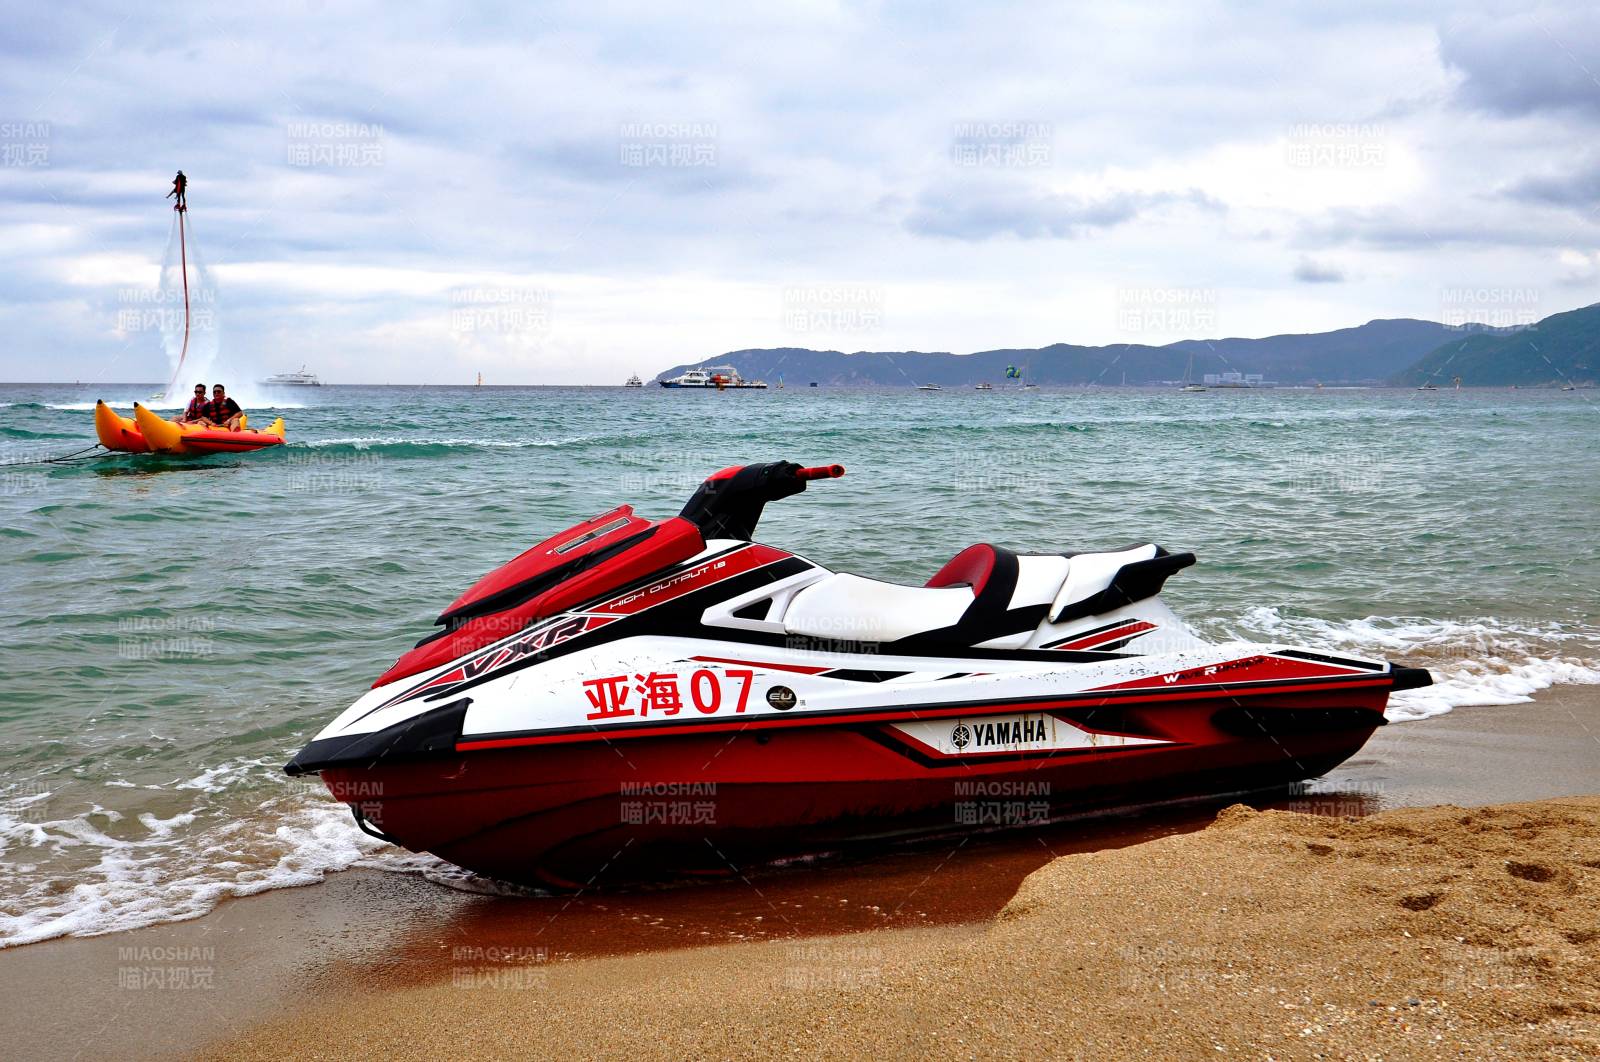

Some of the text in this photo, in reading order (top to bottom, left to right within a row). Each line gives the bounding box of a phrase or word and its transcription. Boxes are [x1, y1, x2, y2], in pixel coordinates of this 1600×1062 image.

[609, 591, 645, 609] HIGH
[649, 566, 709, 594] OUTPUT
[462, 615, 590, 680] VXR
[973, 719, 1047, 747] YAMAHA
